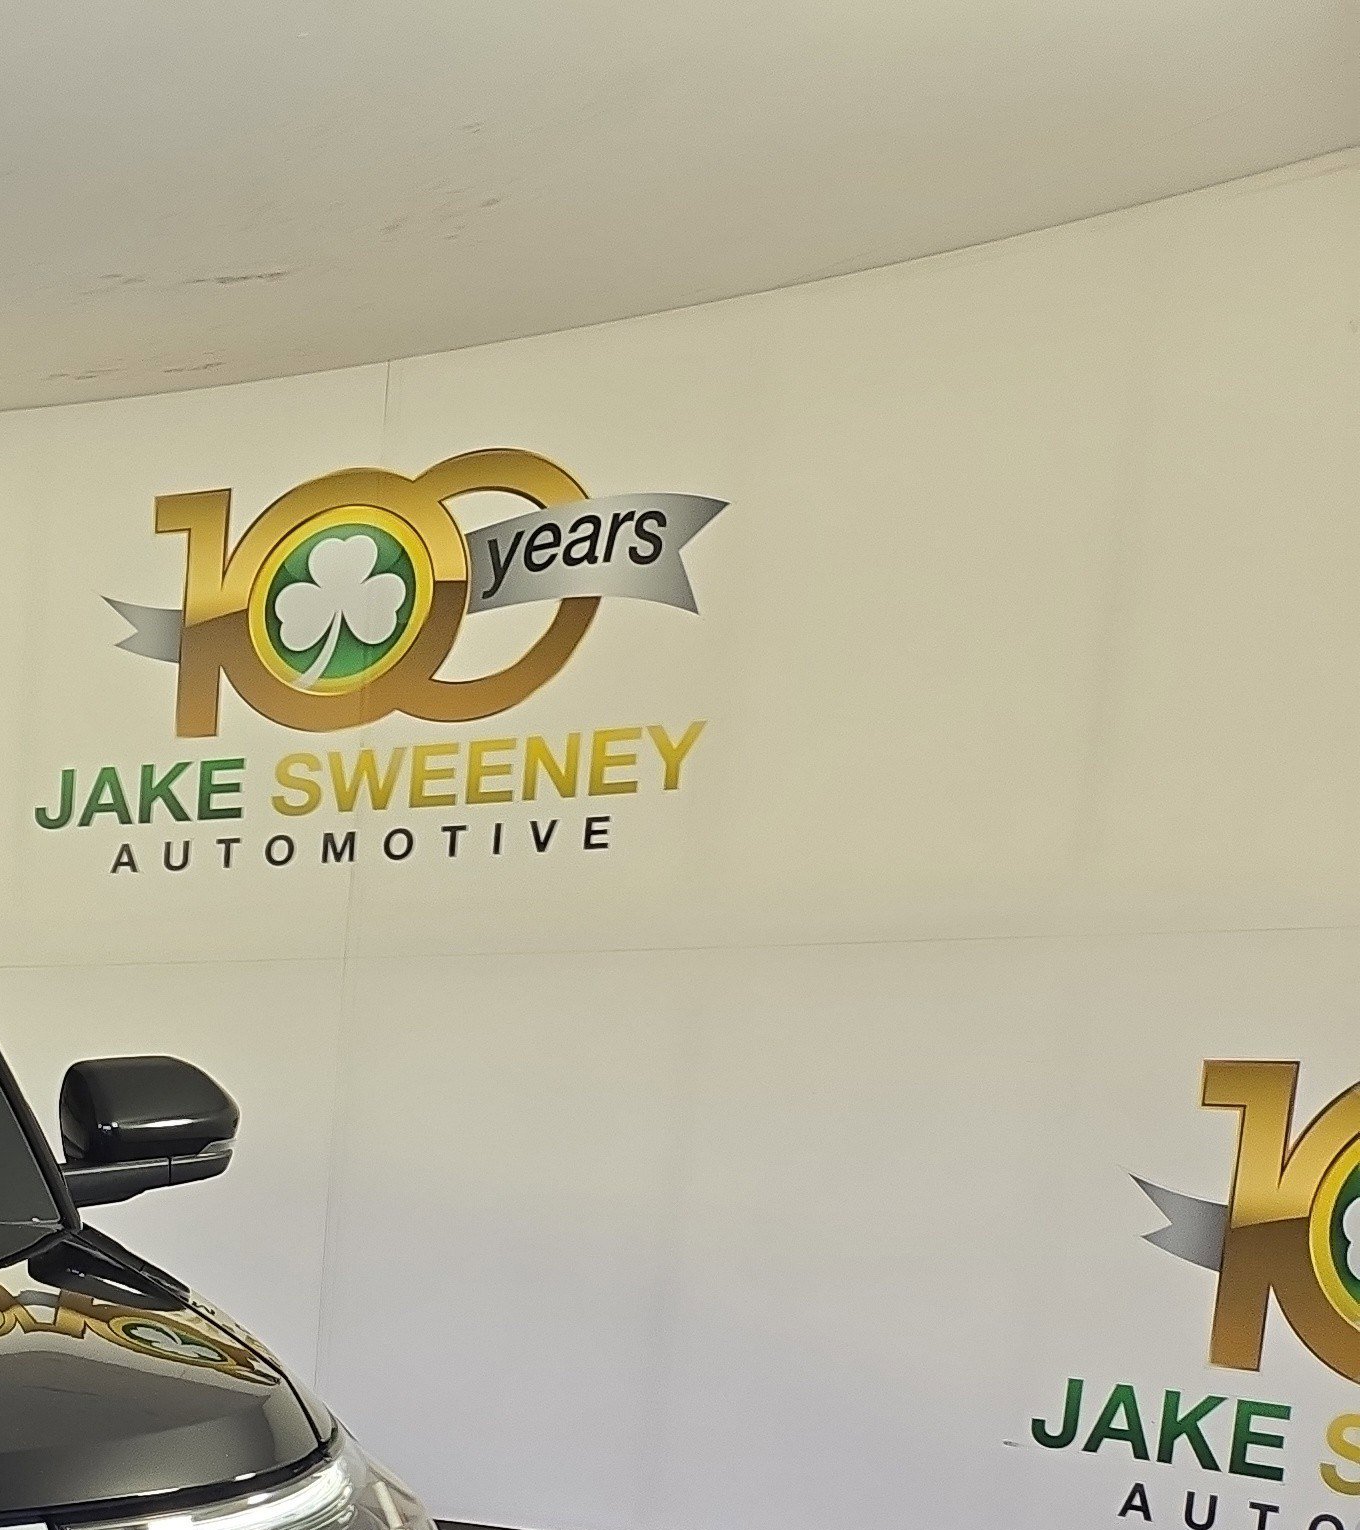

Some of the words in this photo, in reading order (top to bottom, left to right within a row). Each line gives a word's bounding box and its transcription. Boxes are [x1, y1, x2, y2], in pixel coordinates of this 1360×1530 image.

[155, 447, 602, 738] 100
[481, 508, 668, 600] years
[34, 757, 246, 830] JAKE
[271, 720, 707, 817] SWEENEY
[111, 815, 612, 875] AUTOMOTIVE
[1031, 1377, 1292, 1482] JAKE
